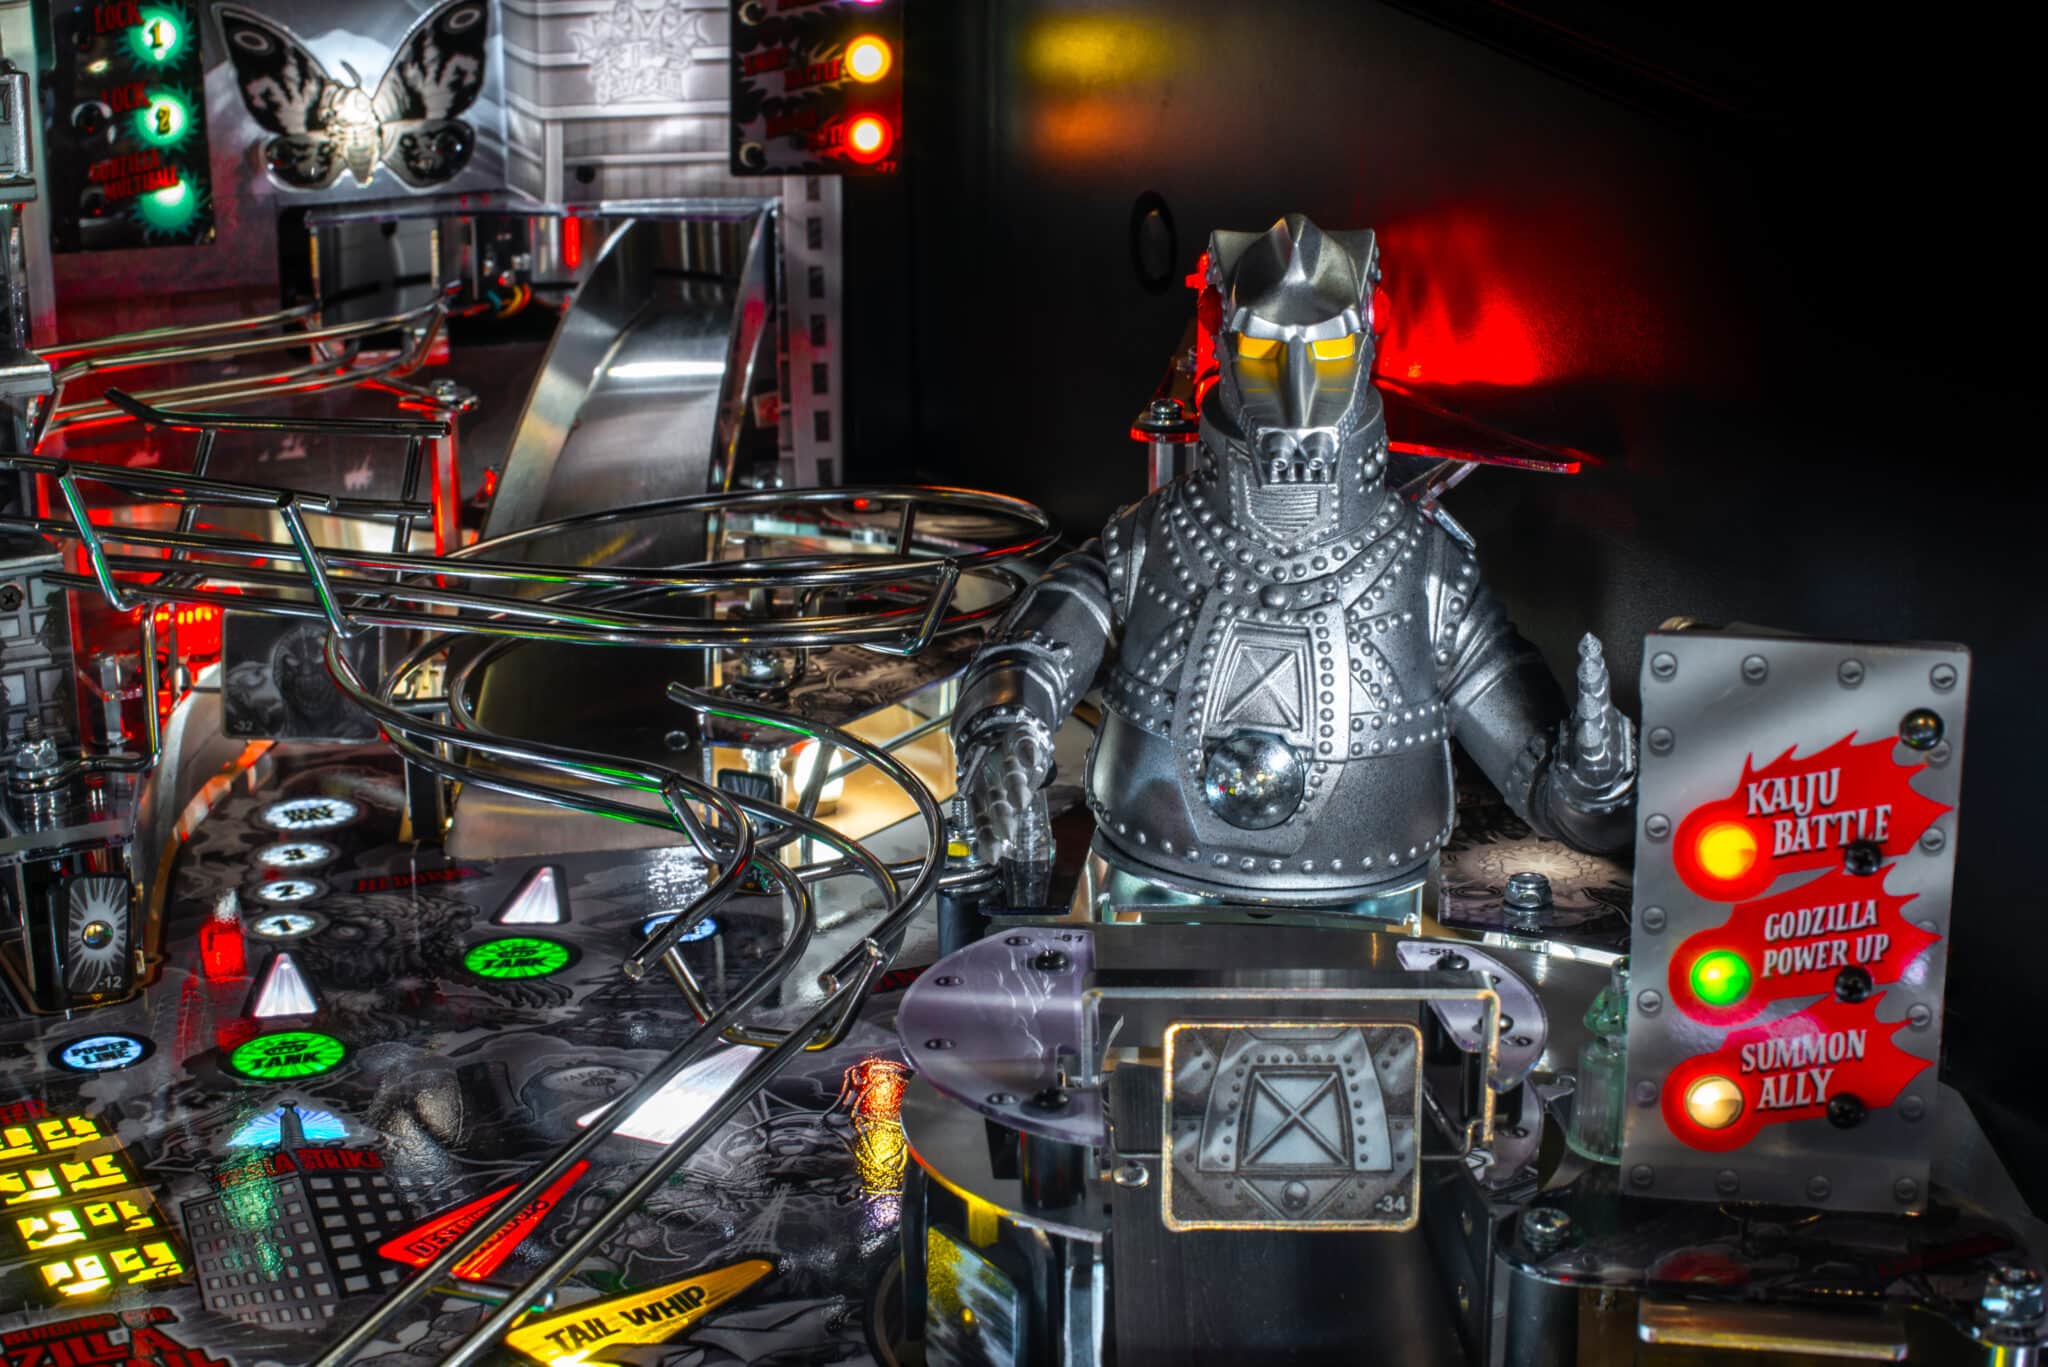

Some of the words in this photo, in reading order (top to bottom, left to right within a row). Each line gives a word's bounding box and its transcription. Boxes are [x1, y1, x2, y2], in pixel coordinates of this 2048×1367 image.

[94, 0, 144, 33] LOCK
[149, 21, 163, 49] 1
[1746, 767, 1841, 817] KAIJU
[1771, 803, 1893, 858] BATTLE
[282, 848, 306, 861] 3
[274, 884, 300, 897] 2
[272, 920, 291, 932] 1
[1763, 899, 1878, 942] GODZILLA
[481, 956, 549, 970] TANK
[1759, 938, 1850, 979] POWER
[1855, 933, 1890, 963] UP
[98, 975, 122, 988] -12
[70, 1041, 134, 1057] POWER
[80, 1048, 133, 1065] LINE
[250, 1051, 321, 1069] TANK
[1740, 1028, 1868, 1073] SUMMON
[1755, 1067, 1835, 1111] ALLY
[215, 1152, 297, 1188] TESLA
[297, 1147, 384, 1169] STRIKE
[1376, 1194, 1406, 1213] -34
[1, 1312, 121, 1349] BUILDING
[544, 1317, 621, 1350] TAIL
[619, 1285, 707, 1327] WHIP
